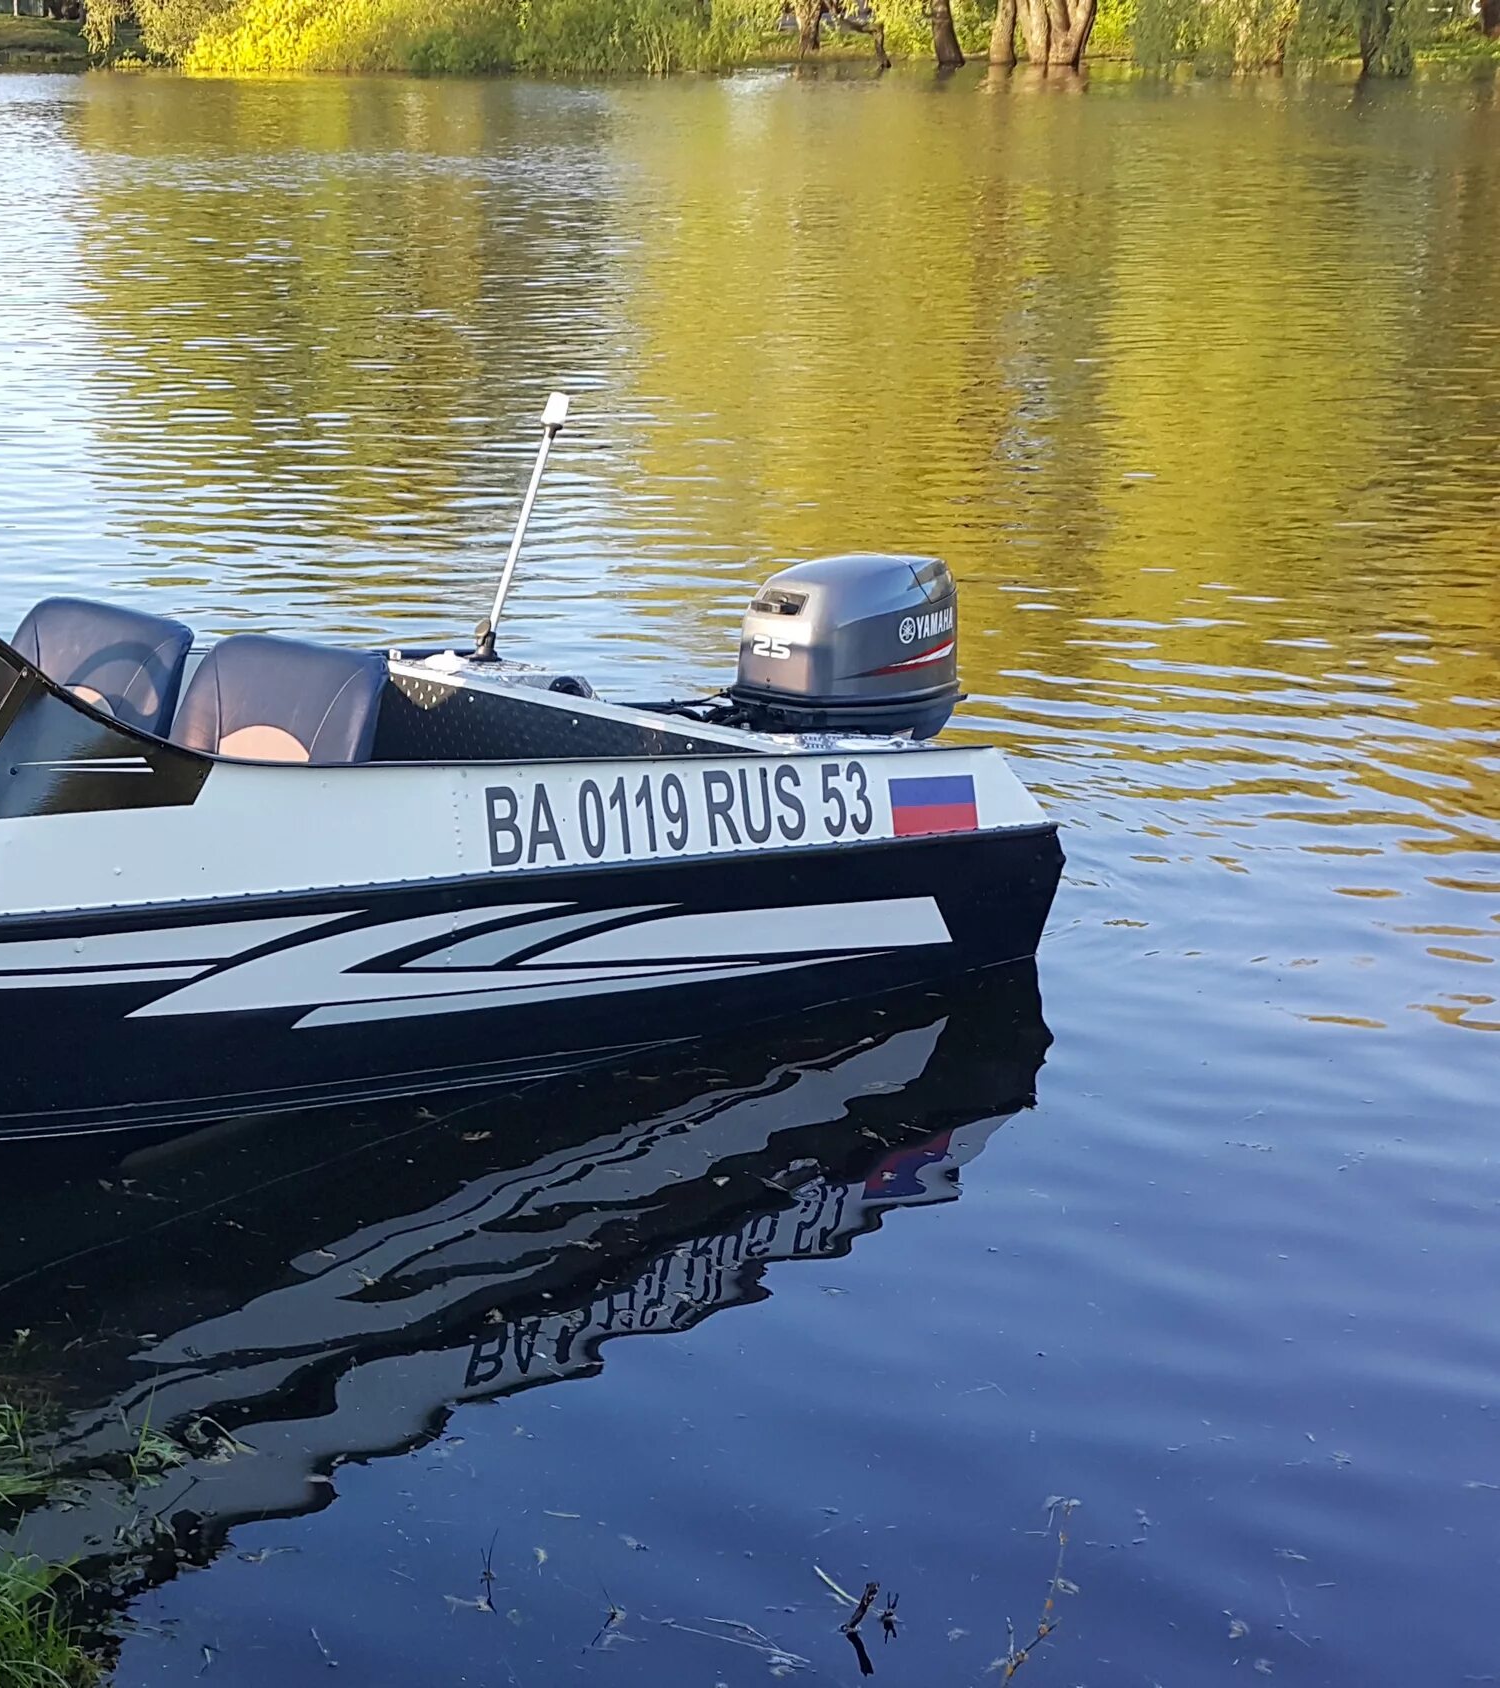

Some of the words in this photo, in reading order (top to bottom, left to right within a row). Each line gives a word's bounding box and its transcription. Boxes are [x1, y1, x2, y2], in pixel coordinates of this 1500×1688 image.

[916, 607, 953, 640] YAMAHA
[753, 635, 791, 659] 25
[485, 784, 566, 867] BA
[579, 773, 688, 859] 0119
[702, 764, 805, 847] RUS
[821, 761, 873, 836] 53
